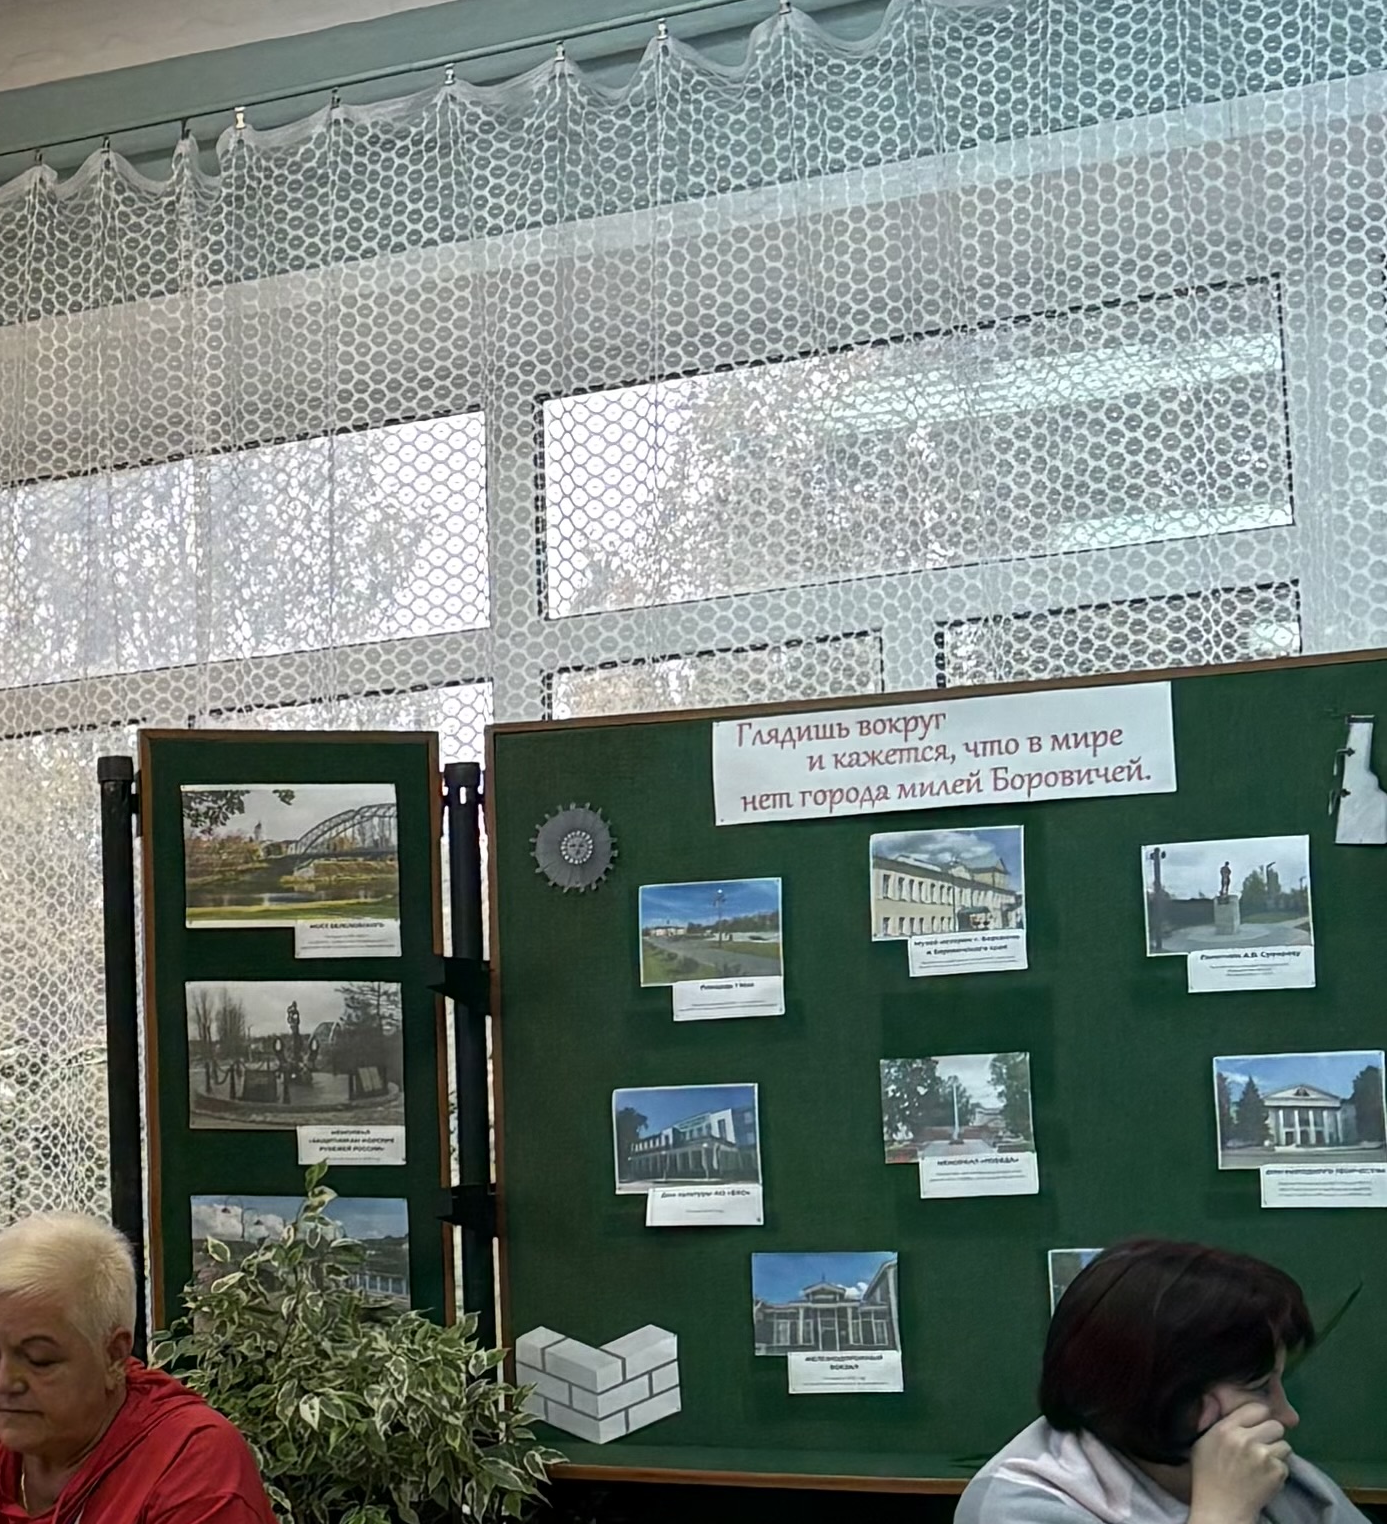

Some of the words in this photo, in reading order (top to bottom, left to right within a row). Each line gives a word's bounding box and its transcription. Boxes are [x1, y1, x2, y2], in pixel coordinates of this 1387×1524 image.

[736, 722, 850, 750] Глядишь
[856, 712, 946, 743] вокруг
[807, 754, 825, 772] и
[832, 744, 956, 770] кажется,
[962, 739, 1019, 758] что
[1029, 735, 1041, 752] в
[1050, 727, 1123, 755] мире
[740, 790, 794, 813] нет
[799, 784, 888, 812] города
[897, 771, 981, 799] милей
[991, 757, 1151, 796] Боровичей.
